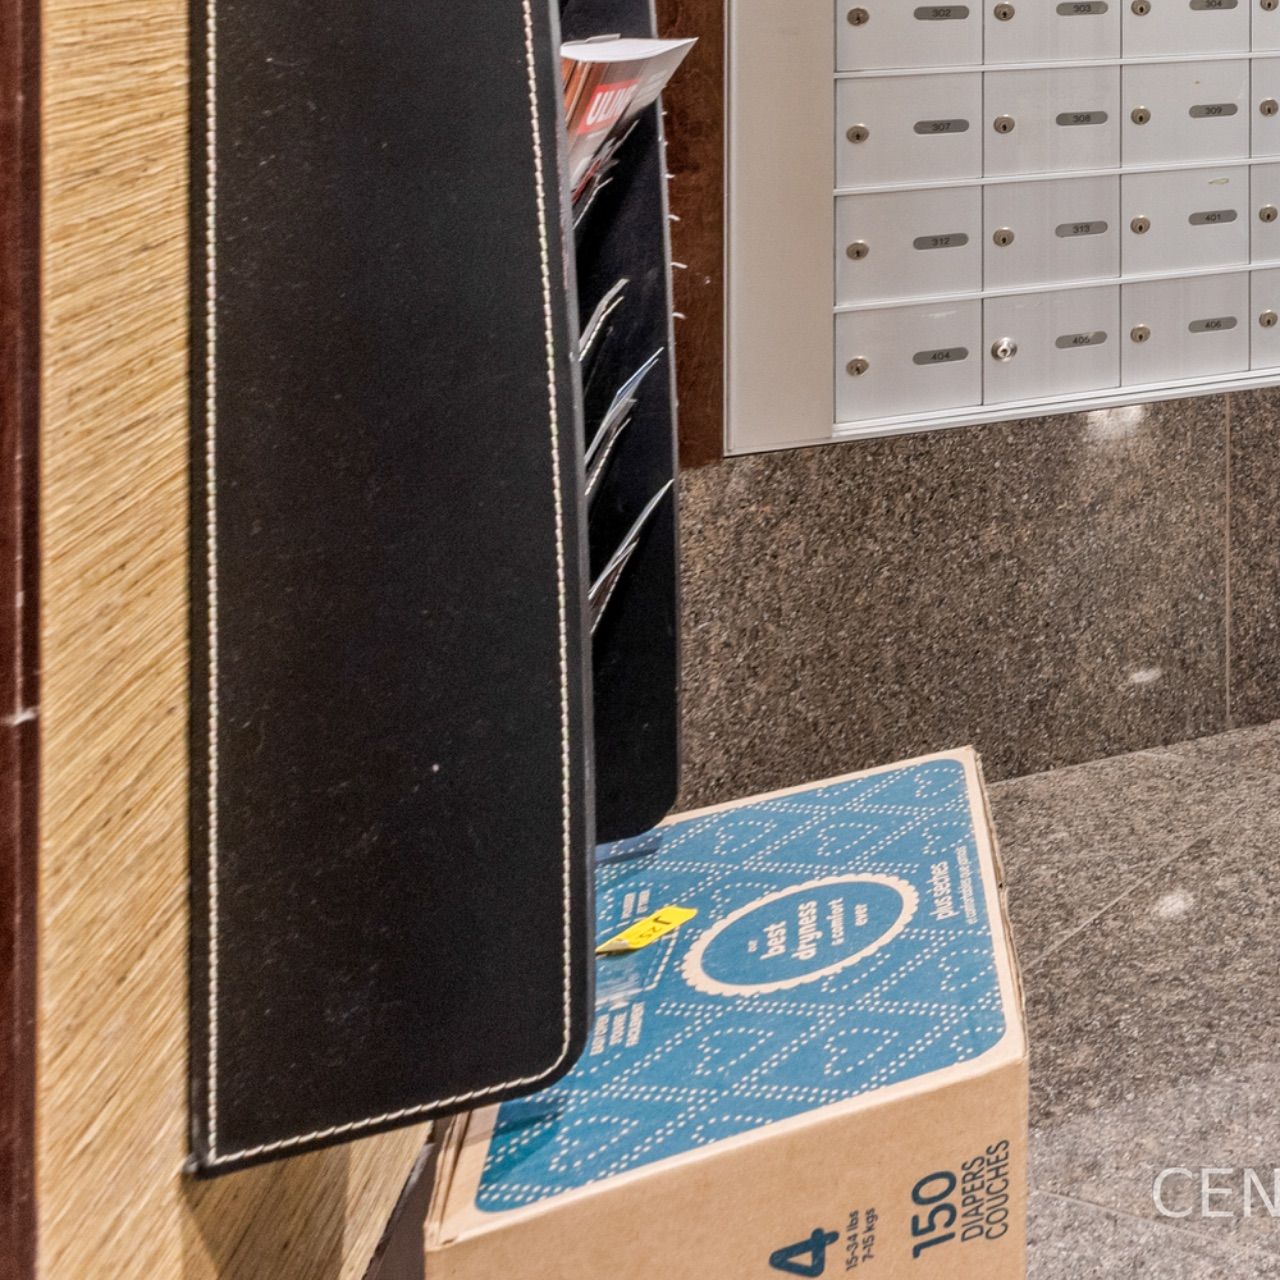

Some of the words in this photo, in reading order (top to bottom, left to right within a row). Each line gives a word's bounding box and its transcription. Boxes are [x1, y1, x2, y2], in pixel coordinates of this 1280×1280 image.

[932, 9, 951, 17] 302
[1073, 4, 1091, 12] 303
[932, 123, 951, 131] 307
[1073, 224, 1090, 233] 313
[932, 238, 950, 246] 312
[931, 352, 950, 360] 404
[826, 897, 844, 936] comfort
[854, 903, 869, 927] ever
[929, 896, 959, 921] plus
[759, 920, 787, 960] best
[792, 900, 823, 960] dryness
[961, 1156, 985, 1242] DIAPERS
[985, 1139, 1010, 1240] COUCHES
[847, 1210, 859, 1231] lbs
[863, 1208, 878, 1233] kgs
[911, 1171, 957, 1259] 150
[769, 1226, 840, 1278] 4
[845, 1233, 859, 1272] 15-34
[862, 1235, 875, 1263] 7-15
